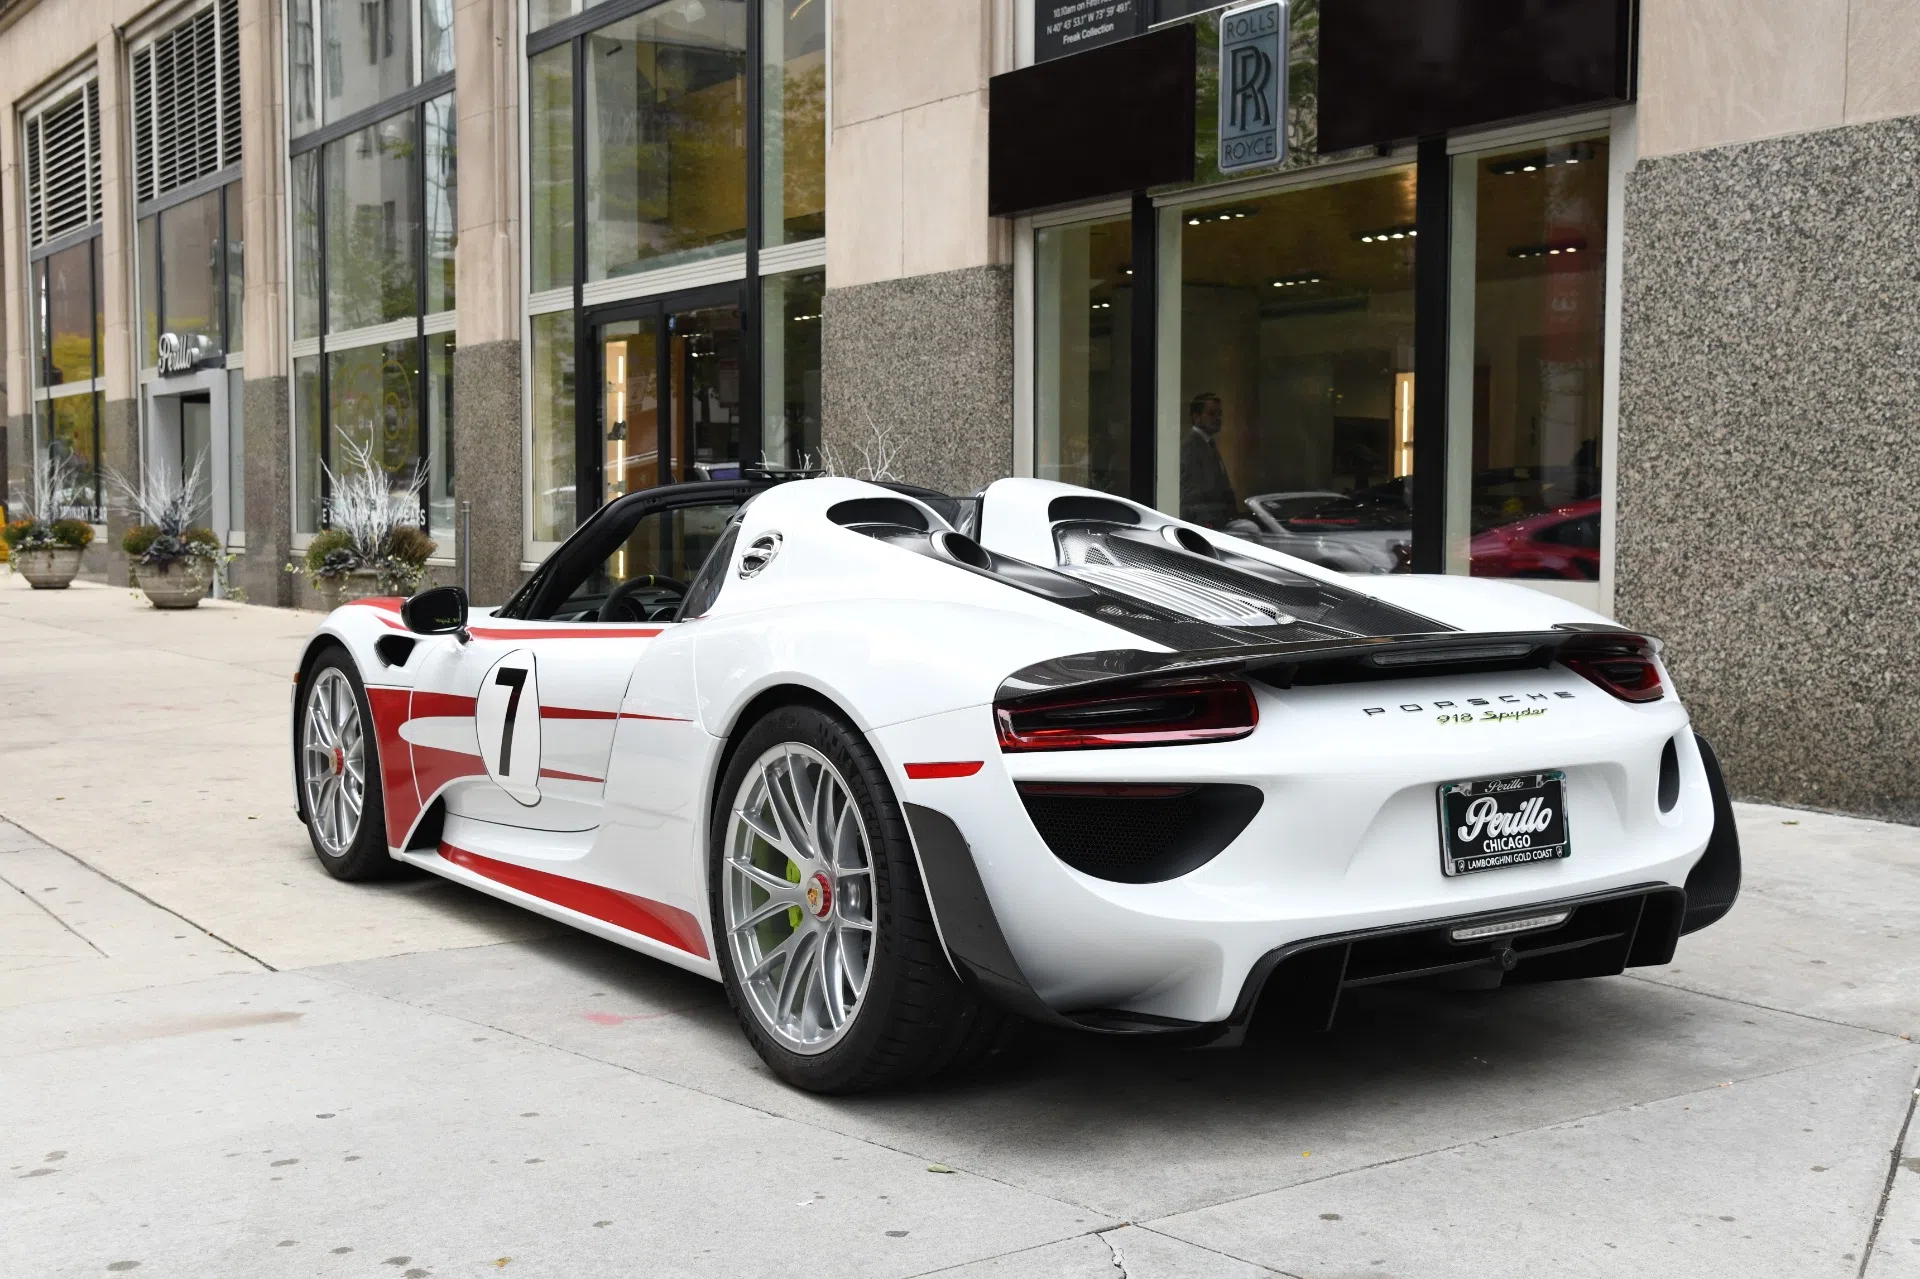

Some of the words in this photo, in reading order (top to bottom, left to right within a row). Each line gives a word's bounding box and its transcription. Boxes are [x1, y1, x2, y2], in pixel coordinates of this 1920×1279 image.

[1046, 26, 1052, 35] N
[1087, 12, 1095, 22] W
[1062, 33, 1081, 45] Freak
[1081, 23, 1114, 39] Collection
[1226, 10, 1275, 38] ROLLS
[1225, 137, 1273, 161] ROYCE
[158, 332, 196, 373] Perillo
[1362, 691, 1576, 717] PORSCHE
[494, 667, 528, 777] 7
[1436, 713, 1473, 726] 918
[1479, 707, 1549, 723] Spyder
[1484, 778, 1524, 795] Perillo
[1457, 796, 1553, 843] Perillo
[1483, 834, 1531, 853] CHICAGO
[1467, 854, 1513, 870] LAMBORGHINI
[1513, 851, 1532, 863] GOLD
[1532, 848, 1553, 861] COAST
